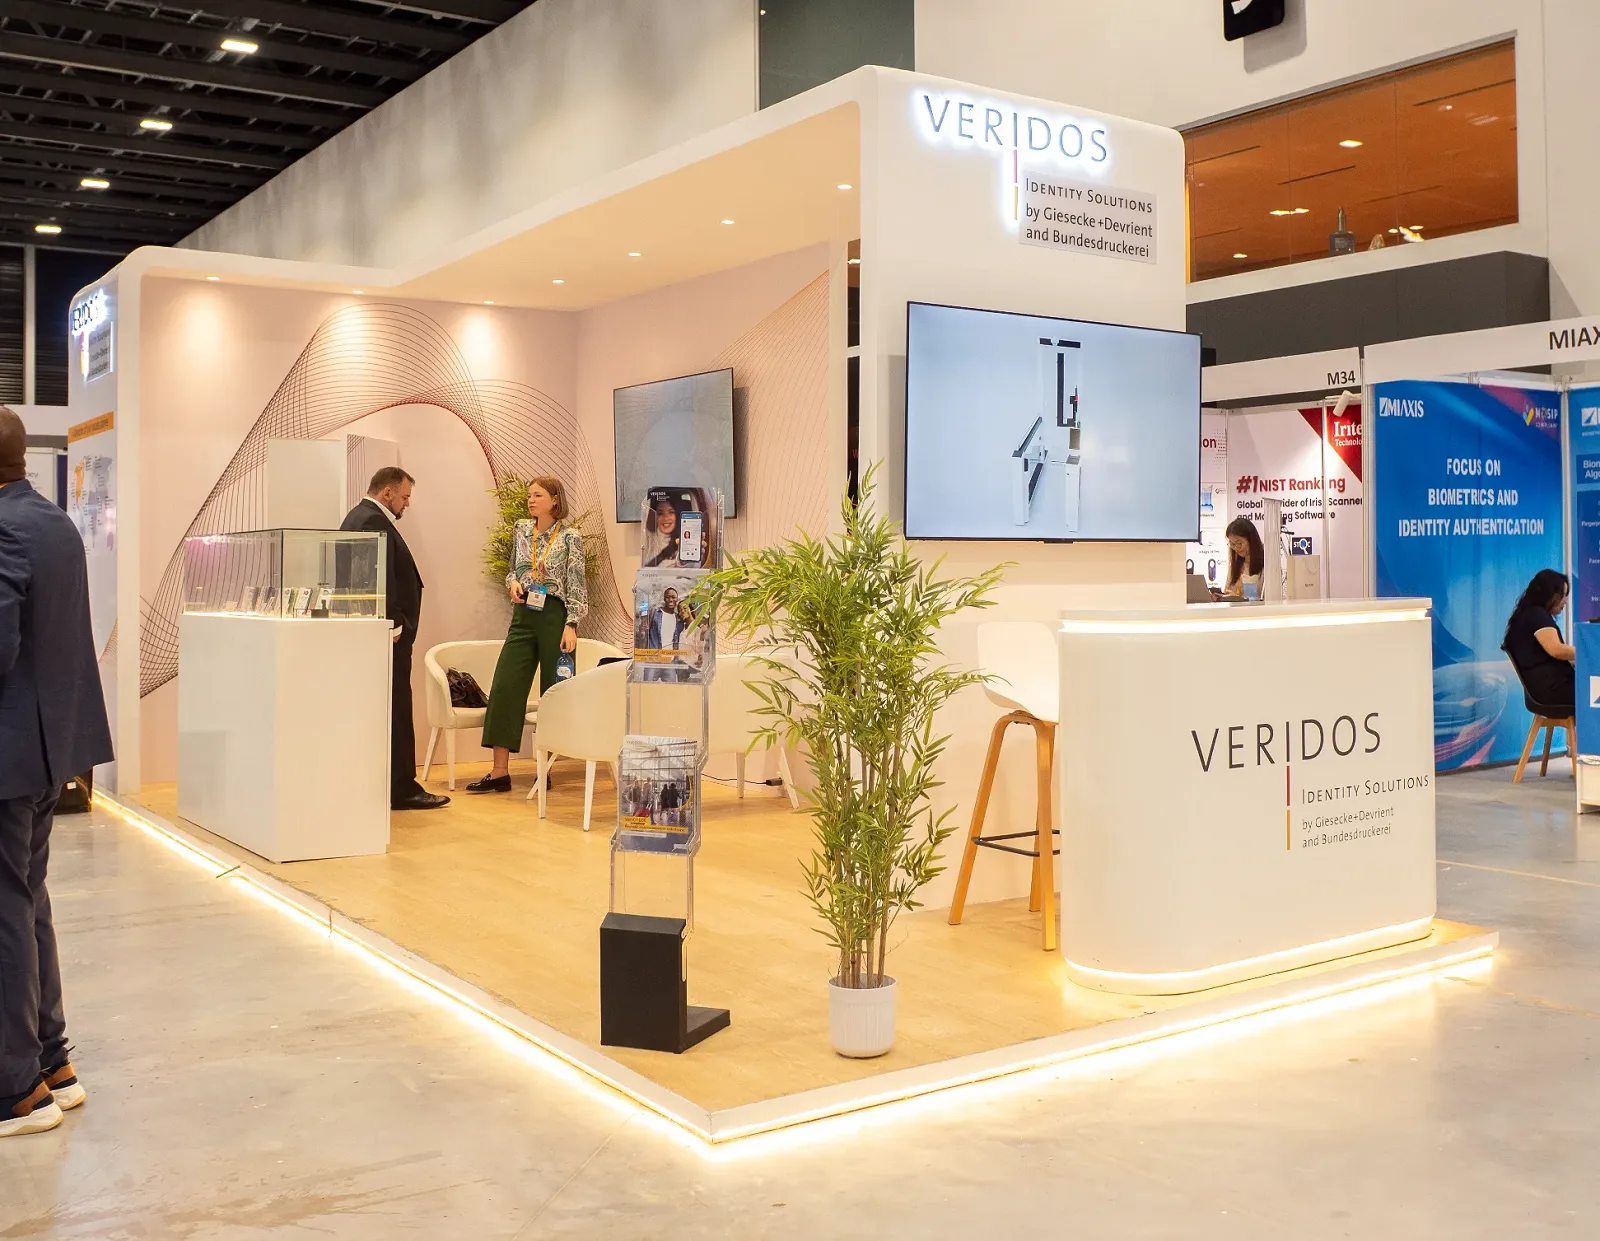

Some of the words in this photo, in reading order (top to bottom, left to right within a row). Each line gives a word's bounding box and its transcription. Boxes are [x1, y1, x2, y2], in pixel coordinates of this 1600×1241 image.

[924, 95, 1107, 162] VERIDOS
[1026, 203, 1040, 221] by
[1026, 227, 1049, 242] and
[1053, 230, 1149, 258] Bundesdruckerei
[1327, 370, 1356, 386] M34
[1388, 398, 1424, 418] MIAXIS
[1200, 434, 1217, 449] on
[1447, 458, 1482, 476] FOCUS
[1485, 459, 1501, 476] ON
[1260, 479, 1286, 492] NIST
[1289, 477, 1346, 493] Ranking
[1236, 500, 1263, 509] Global
[1300, 497, 1309, 507] of
[1428, 488, 1495, 506] BIOMETRICS
[1497, 489, 1519, 506] AND
[1399, 519, 1450, 537] IDENTITY
[1453, 518, 1544, 536] AUTHENTICATION
[1191, 712, 1381, 772] VERIDOS
[1302, 819, 1313, 832] by
[1315, 807, 1394, 828] Giesecke+Devrient
[1302, 835, 1319, 848] and
[1322, 823, 1391, 845] Bundesdruckerei
